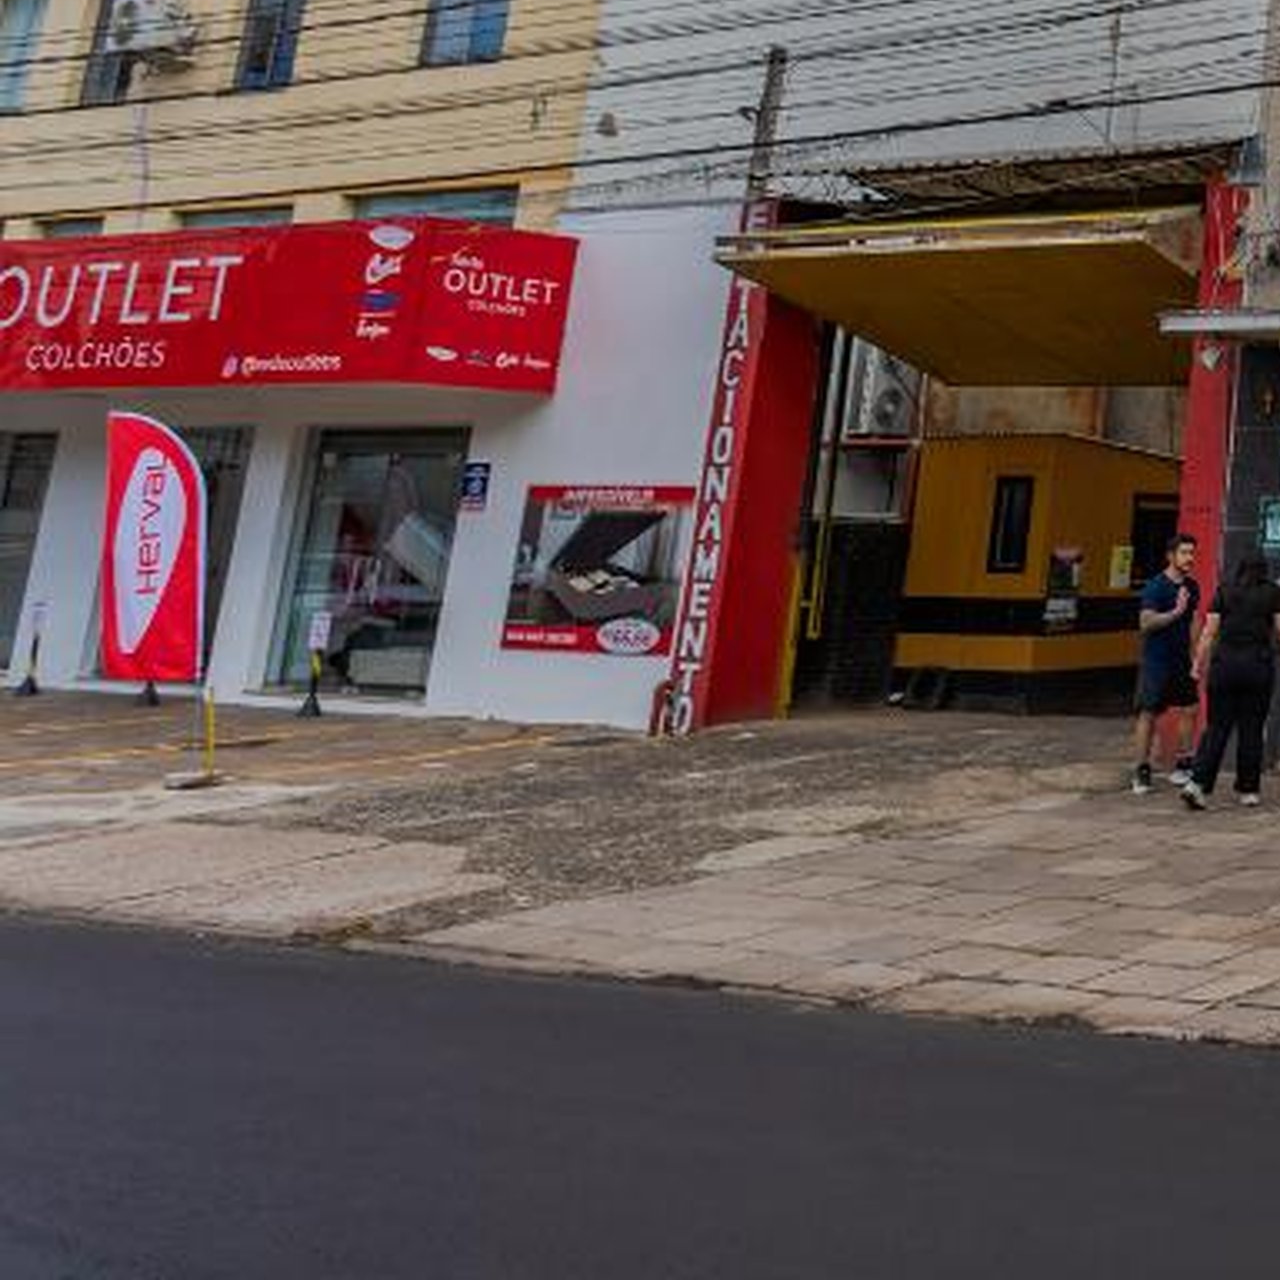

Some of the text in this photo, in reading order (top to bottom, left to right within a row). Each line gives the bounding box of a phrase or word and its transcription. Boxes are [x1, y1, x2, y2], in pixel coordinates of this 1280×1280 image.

[0, 255, 244, 329] OUTLET
[444, 269, 559, 305] OUTLET
[26, 337, 166, 371] COLCHÕES
[671, 204, 768, 736] ETACIONAMENTO
[137, 459, 167, 594] Herval
